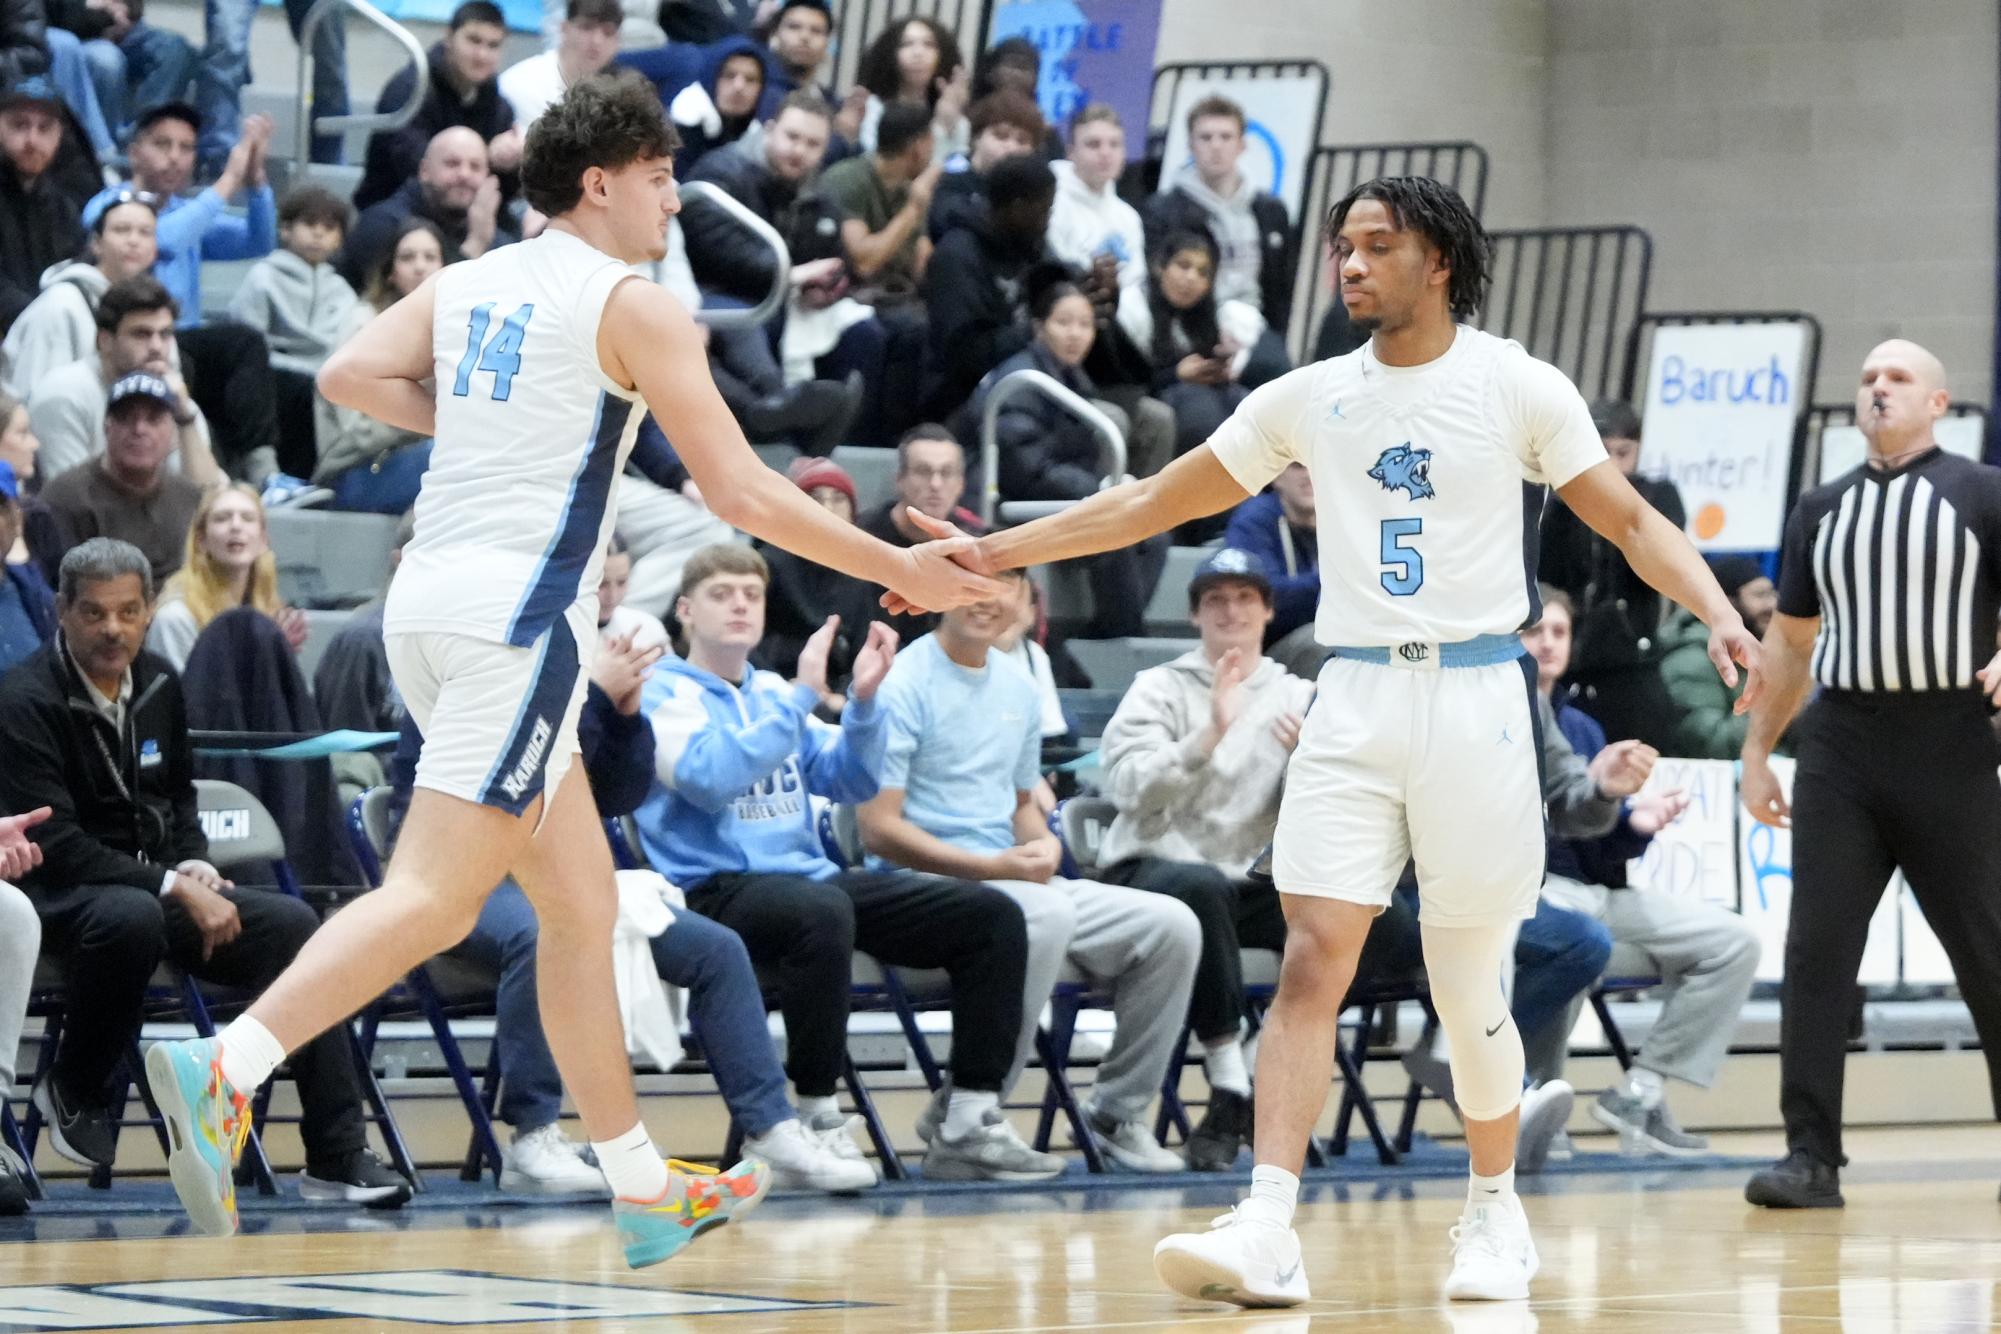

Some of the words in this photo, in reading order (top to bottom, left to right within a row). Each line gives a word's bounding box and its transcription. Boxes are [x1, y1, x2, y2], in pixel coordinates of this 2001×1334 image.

[453, 302, 535, 402] 14
[1661, 354, 1789, 404] Baruch
[1380, 517, 1424, 597] 5
[501, 713, 551, 802] BARUCH
[197, 808, 249, 840] UCH
